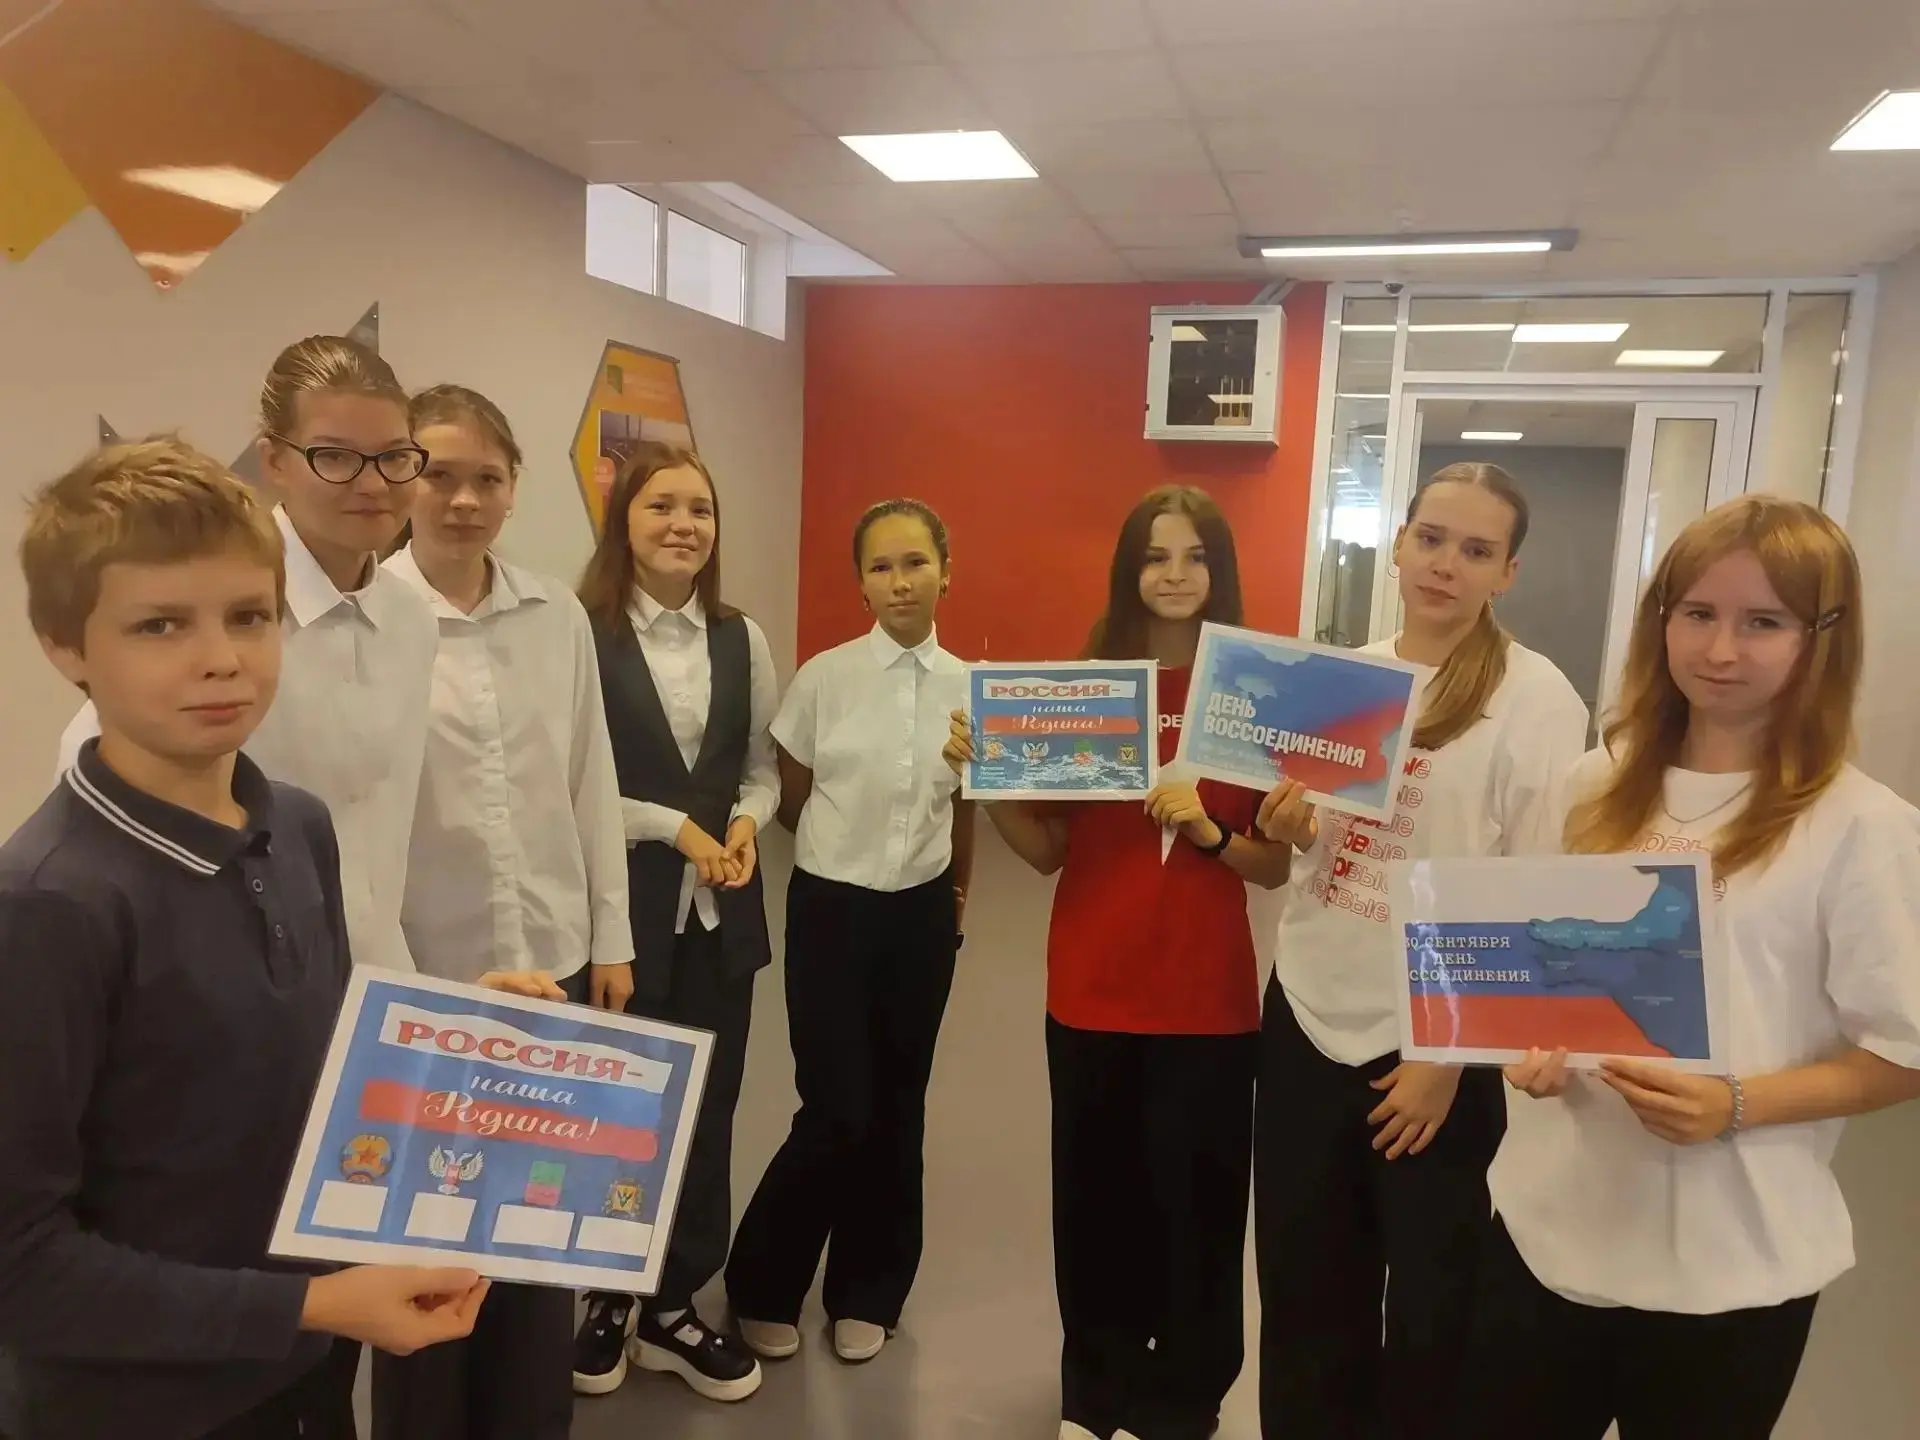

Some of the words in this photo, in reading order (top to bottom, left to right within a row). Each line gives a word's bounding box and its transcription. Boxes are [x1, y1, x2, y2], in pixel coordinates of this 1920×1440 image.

[990, 684, 1121, 698] РОССИЯ-
[1206, 692, 1257, 719] ДЕНЬ
[1203, 714, 1367, 769] ВОССОЕДИНЕНИЯ
[1424, 936, 1512, 949] СЕНТЯБРЯ
[1433, 952, 1477, 966] ДЕНЬ
[396, 1019, 644, 1083] РОССИЯ-
[423, 1089, 600, 1142] Родина!
